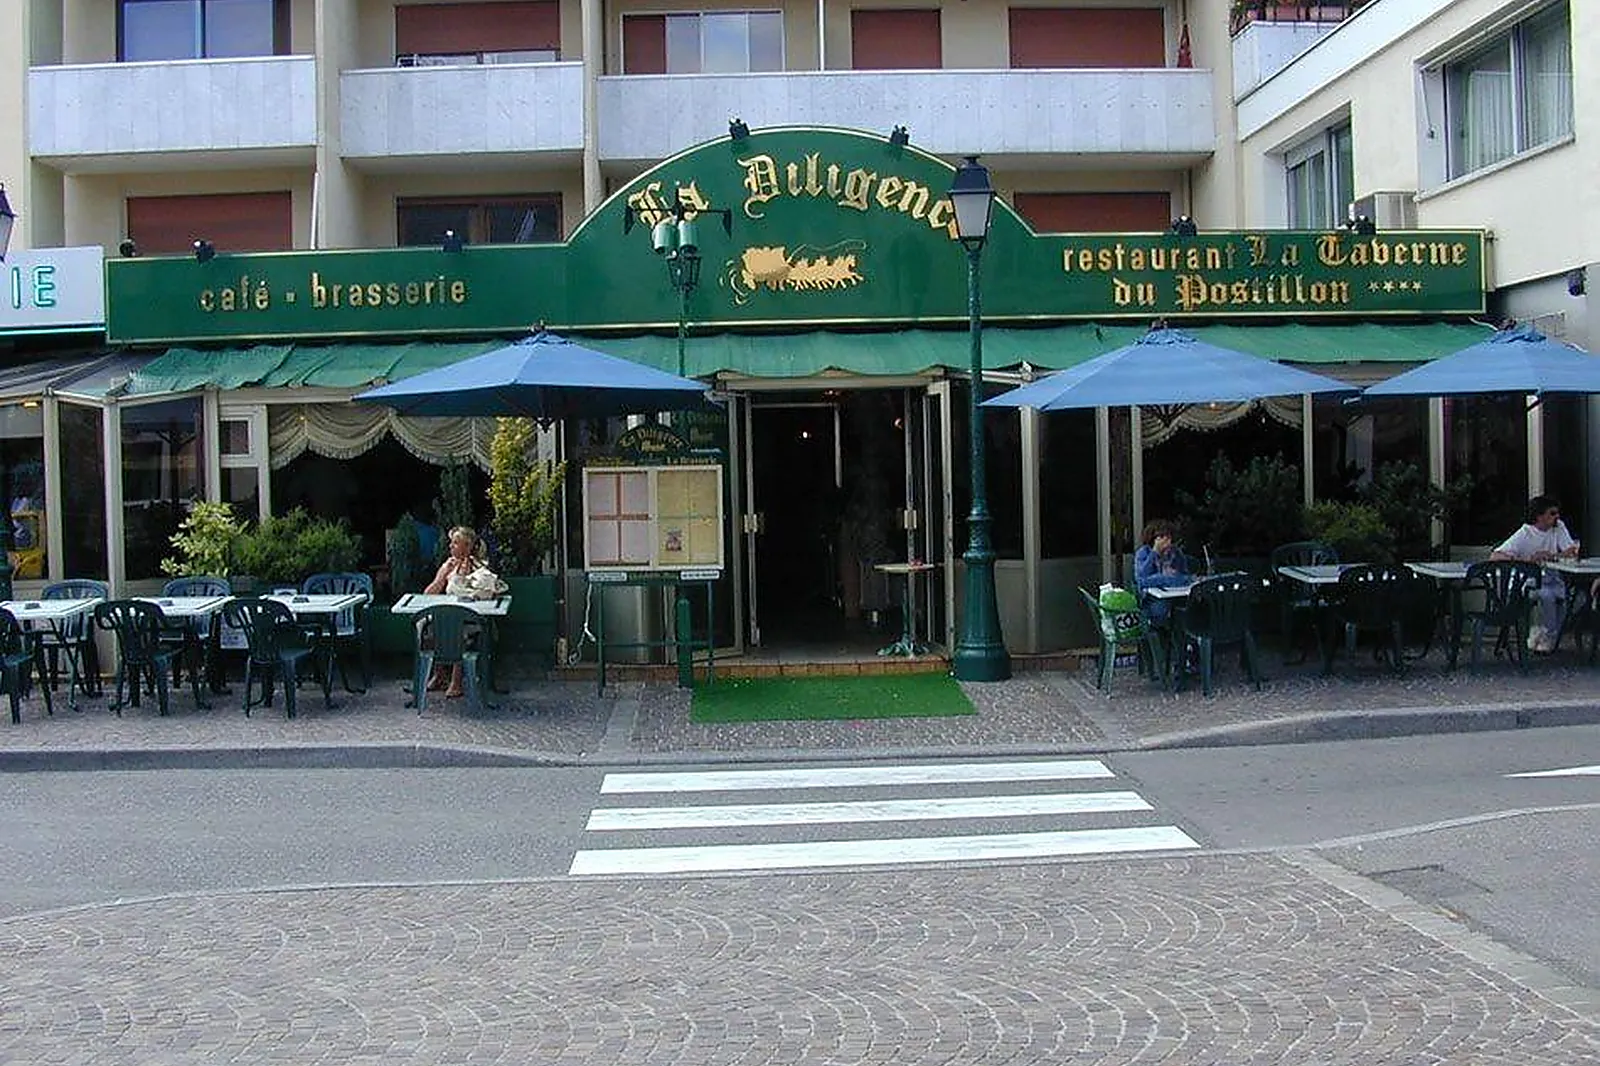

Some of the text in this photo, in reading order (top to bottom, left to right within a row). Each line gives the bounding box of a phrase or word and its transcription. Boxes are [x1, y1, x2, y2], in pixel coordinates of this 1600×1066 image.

[628, 152, 959, 241] La Diligenc
[1062, 234, 1468, 272] restaurant La Taverne
[201, 274, 270, 312] café
[311, 272, 466, 308] brasserie
[1113, 273, 1350, 311] du Postillon
